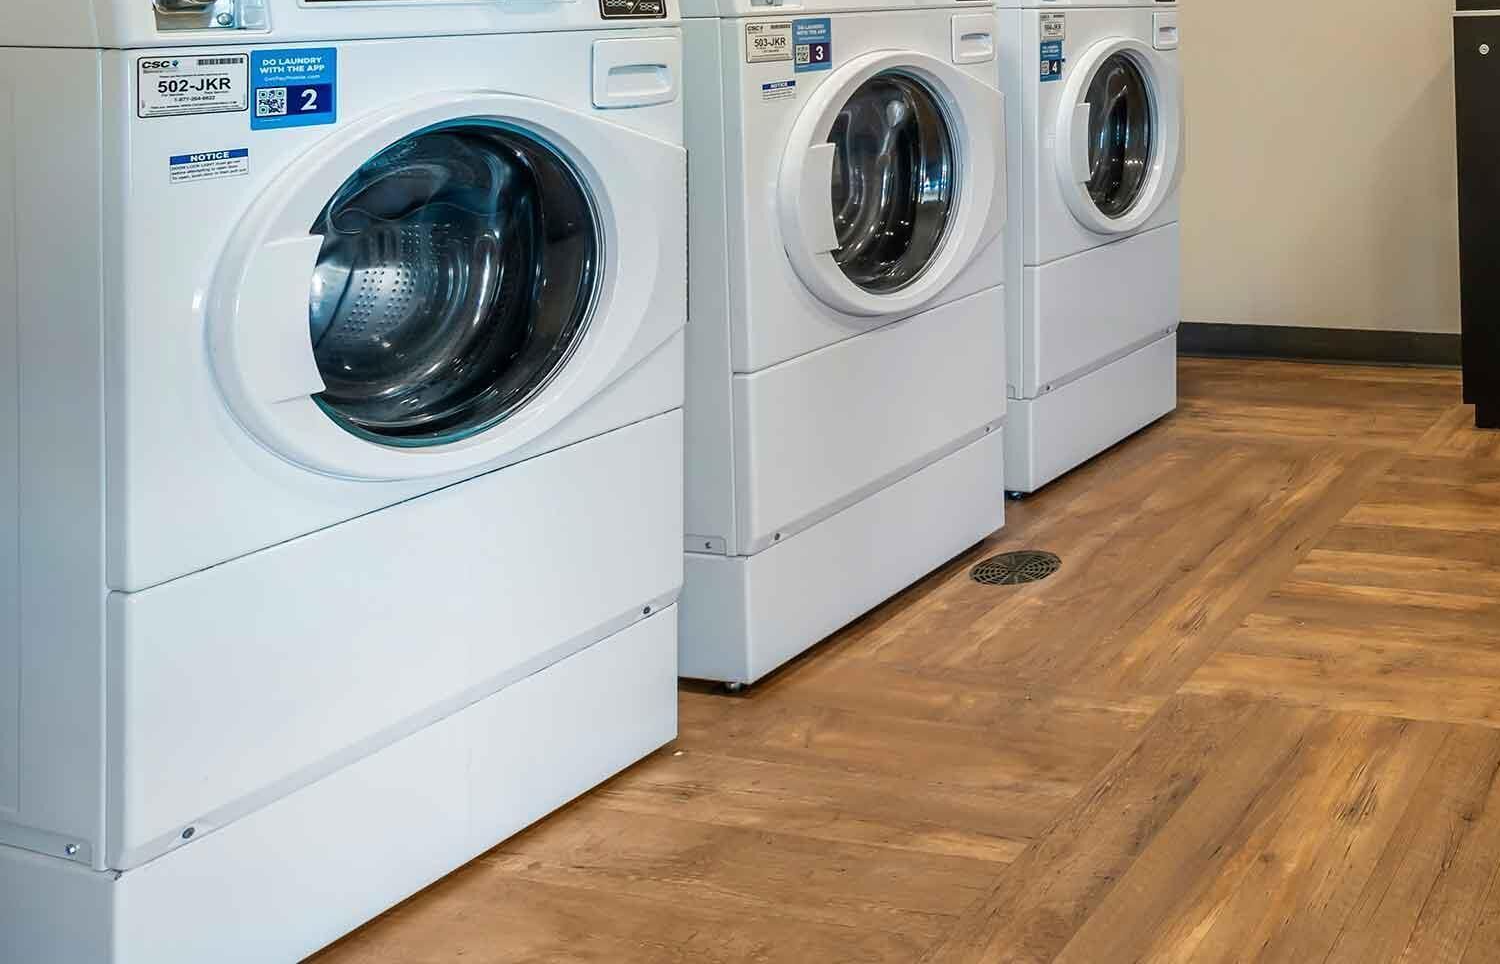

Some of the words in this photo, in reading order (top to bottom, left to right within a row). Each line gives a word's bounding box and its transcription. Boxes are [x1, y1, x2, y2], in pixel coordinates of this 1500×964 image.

[754, 37, 786, 48] 503-JKR
[815, 45, 824, 61] 3
[141, 60, 171, 69] CSC
[278, 56, 322, 65] LAUNDRY
[259, 65, 285, 74] WITH
[287, 64, 305, 73] THE
[306, 63, 325, 72] APP
[1052, 61, 1058, 73] 4
[157, 77, 231, 93] 502-JKR
[300, 88, 318, 111] 2
[190, 151, 230, 162] NOTICE
